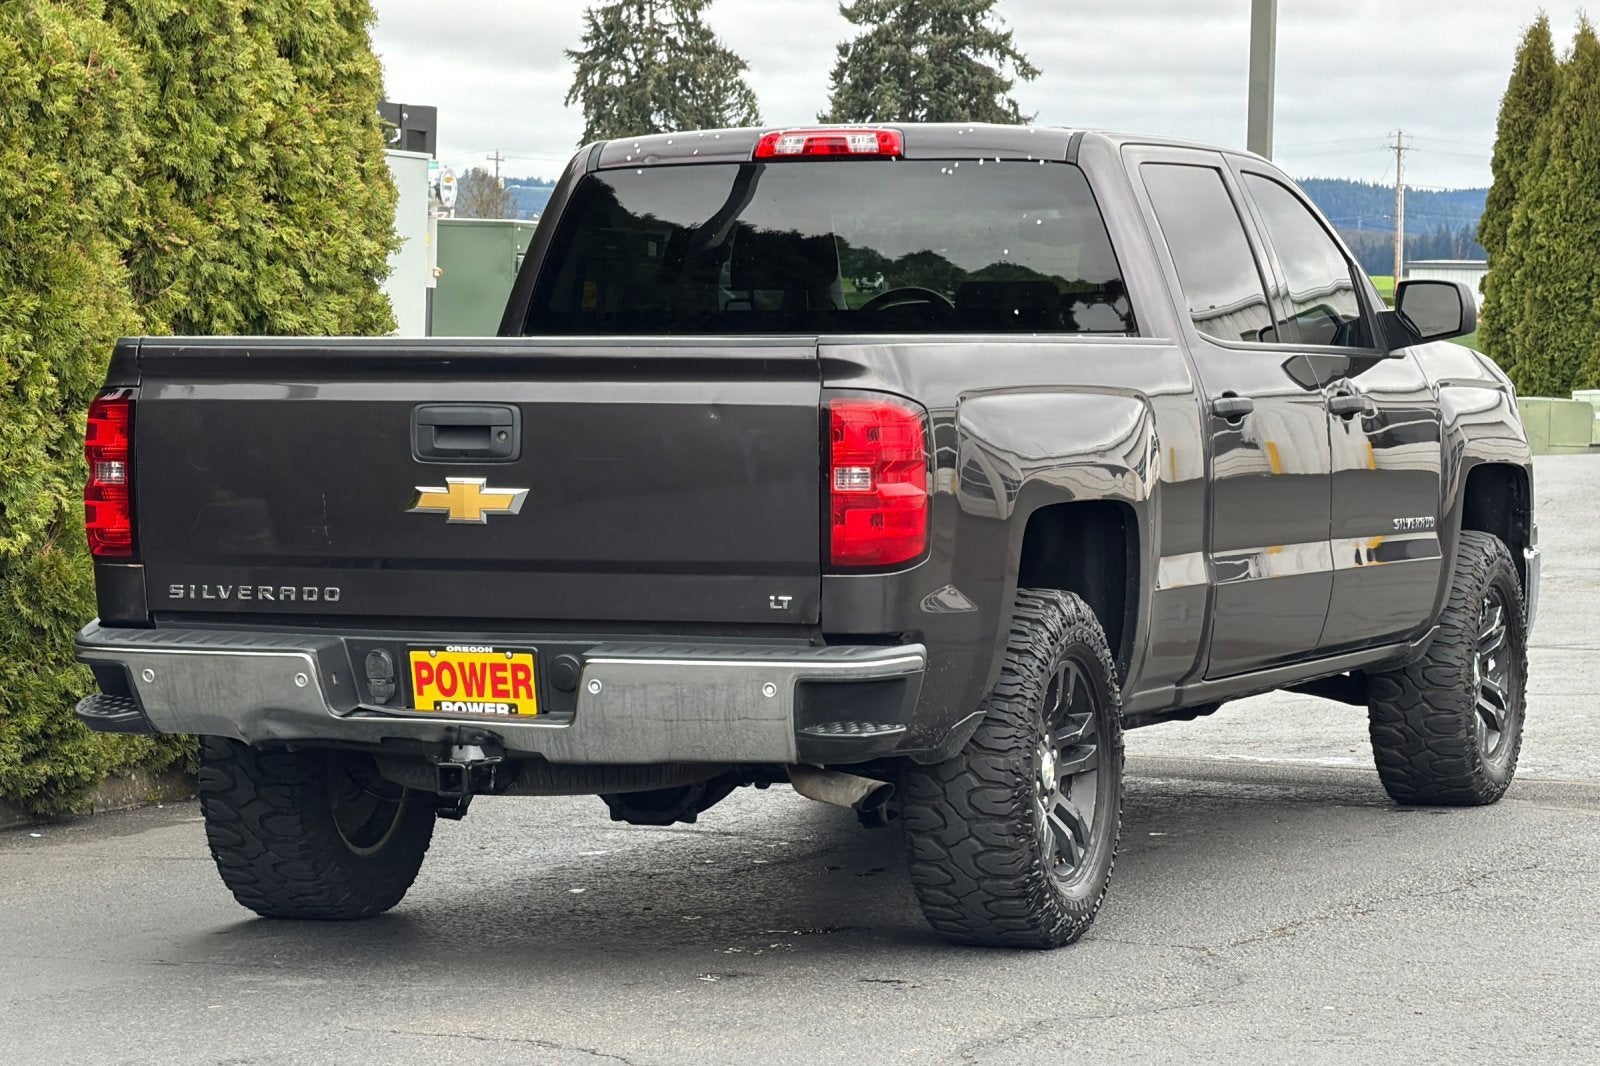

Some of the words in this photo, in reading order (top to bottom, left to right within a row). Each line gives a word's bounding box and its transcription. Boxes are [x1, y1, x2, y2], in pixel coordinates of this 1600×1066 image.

[1392, 516, 1435, 530] SILVERADO
[169, 585, 340, 602] SILVERADO
[769, 595, 793, 610] LT
[446, 645, 493, 653] OREGON
[414, 661, 533, 699] POWER
[441, 701, 509, 714] POWER
